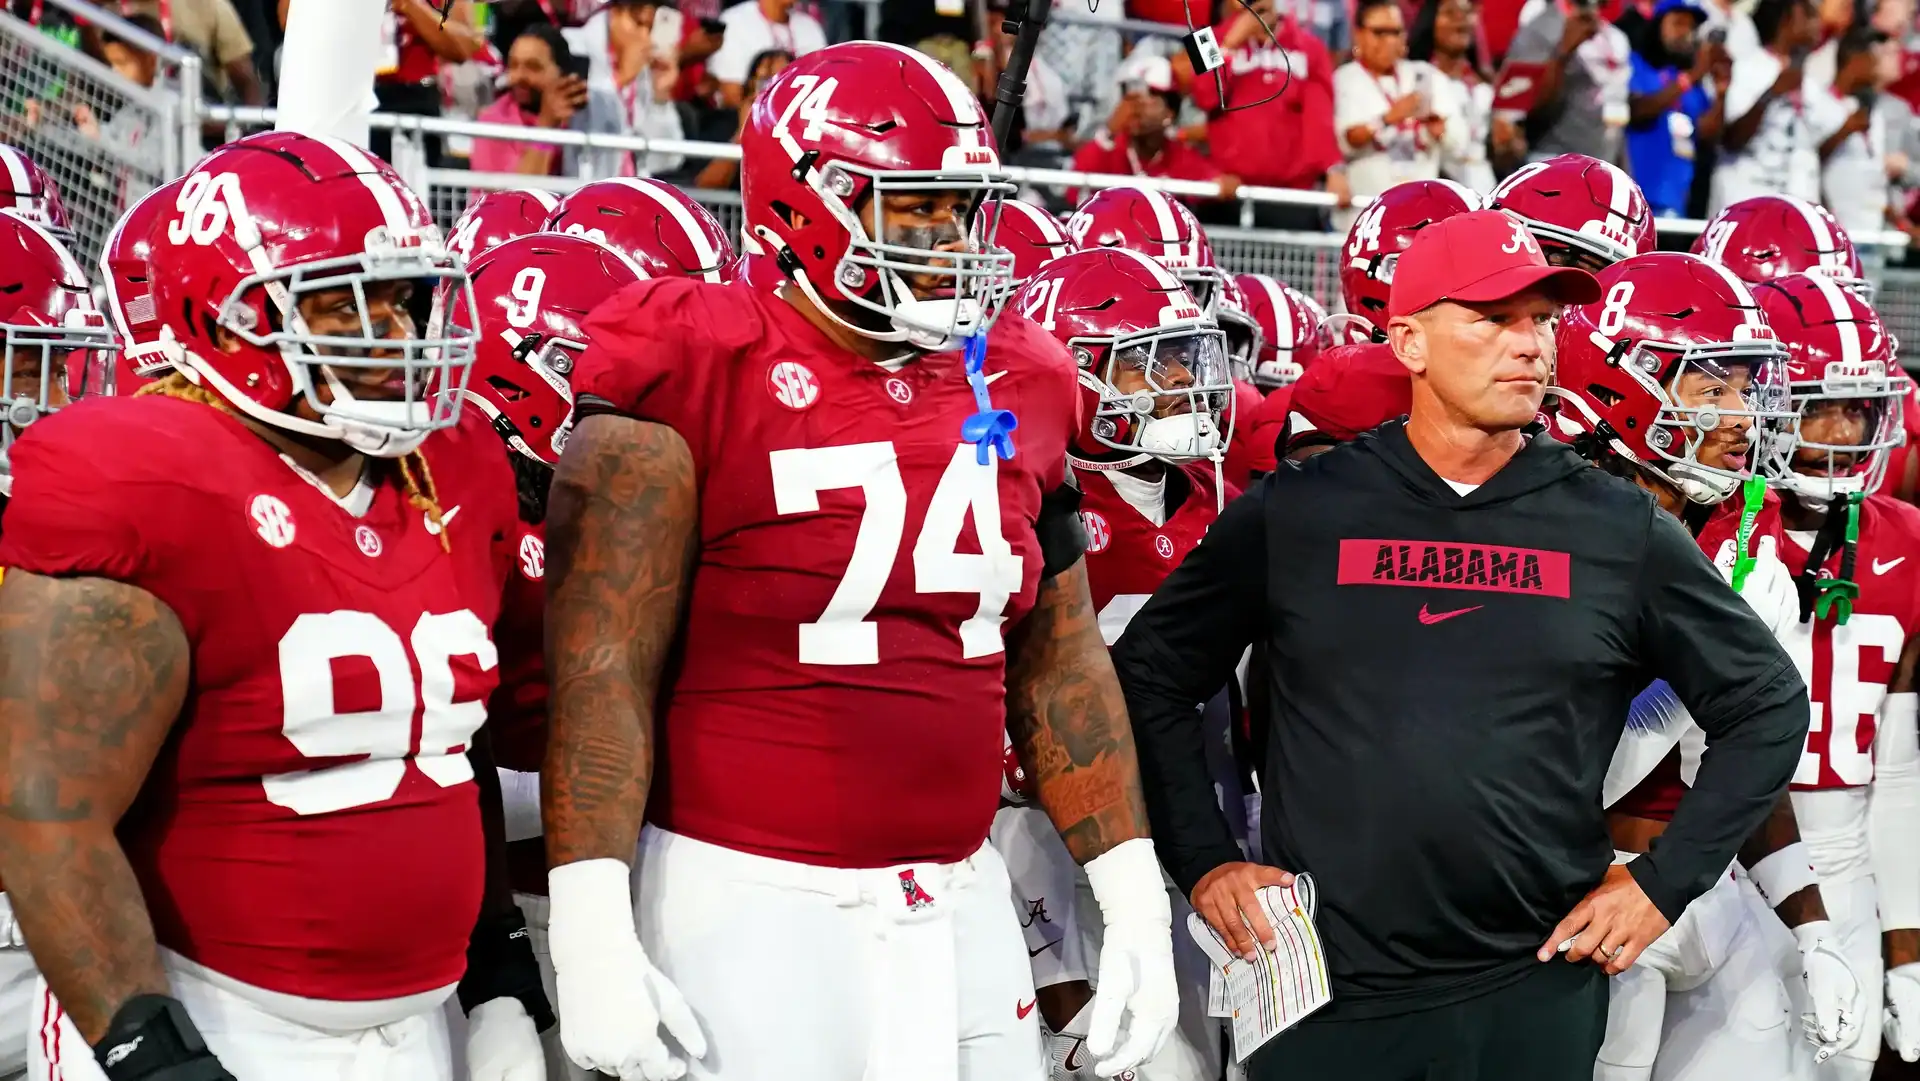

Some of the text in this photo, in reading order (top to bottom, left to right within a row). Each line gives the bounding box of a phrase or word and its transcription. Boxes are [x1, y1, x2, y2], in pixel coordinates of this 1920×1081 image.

[772, 75, 839, 142] 74
[168, 171, 240, 246] 96
[1349, 205, 1387, 257] 34
[1600, 224, 1628, 247] BAMA
[1501, 221, 1537, 254] A
[506, 267, 547, 328] 9
[1023, 277, 1065, 331] 21
[1174, 307, 1201, 320] BAMA
[1598, 281, 1636, 337] 8
[771, 361, 819, 409] SEC
[1071, 459, 1133, 471] CRIMSON TIDE
[250, 493, 297, 549] SEC
[769, 441, 1024, 666] 74
[1372, 544, 1543, 590] ALABAMA
[261, 608, 499, 816] 96
